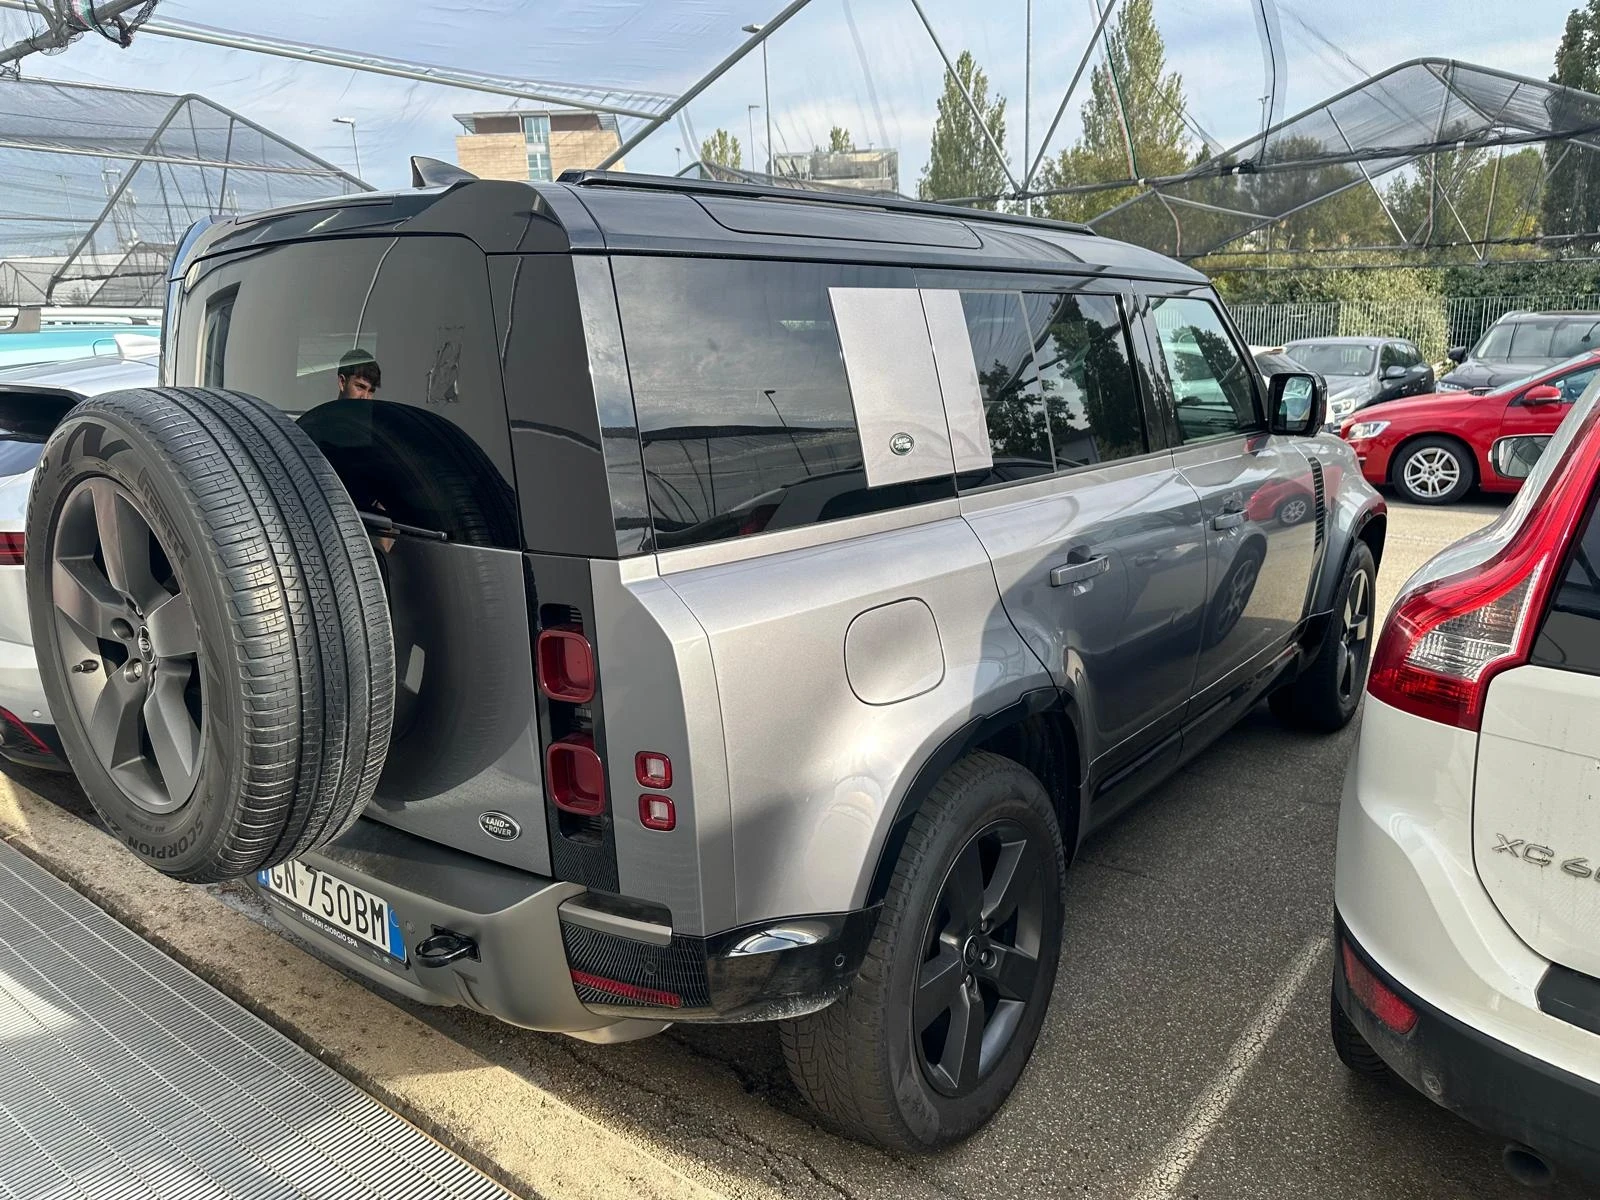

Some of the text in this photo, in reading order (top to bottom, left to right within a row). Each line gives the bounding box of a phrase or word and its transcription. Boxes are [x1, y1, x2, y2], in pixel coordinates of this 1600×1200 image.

[127, 812, 204, 859] SCORPION
[486, 817, 505, 828] LAND
[488, 825, 512, 837] ROVER
[305, 866, 387, 946] 750BM
[302, 912, 359, 948] FERRARI GIORGIO SPA
